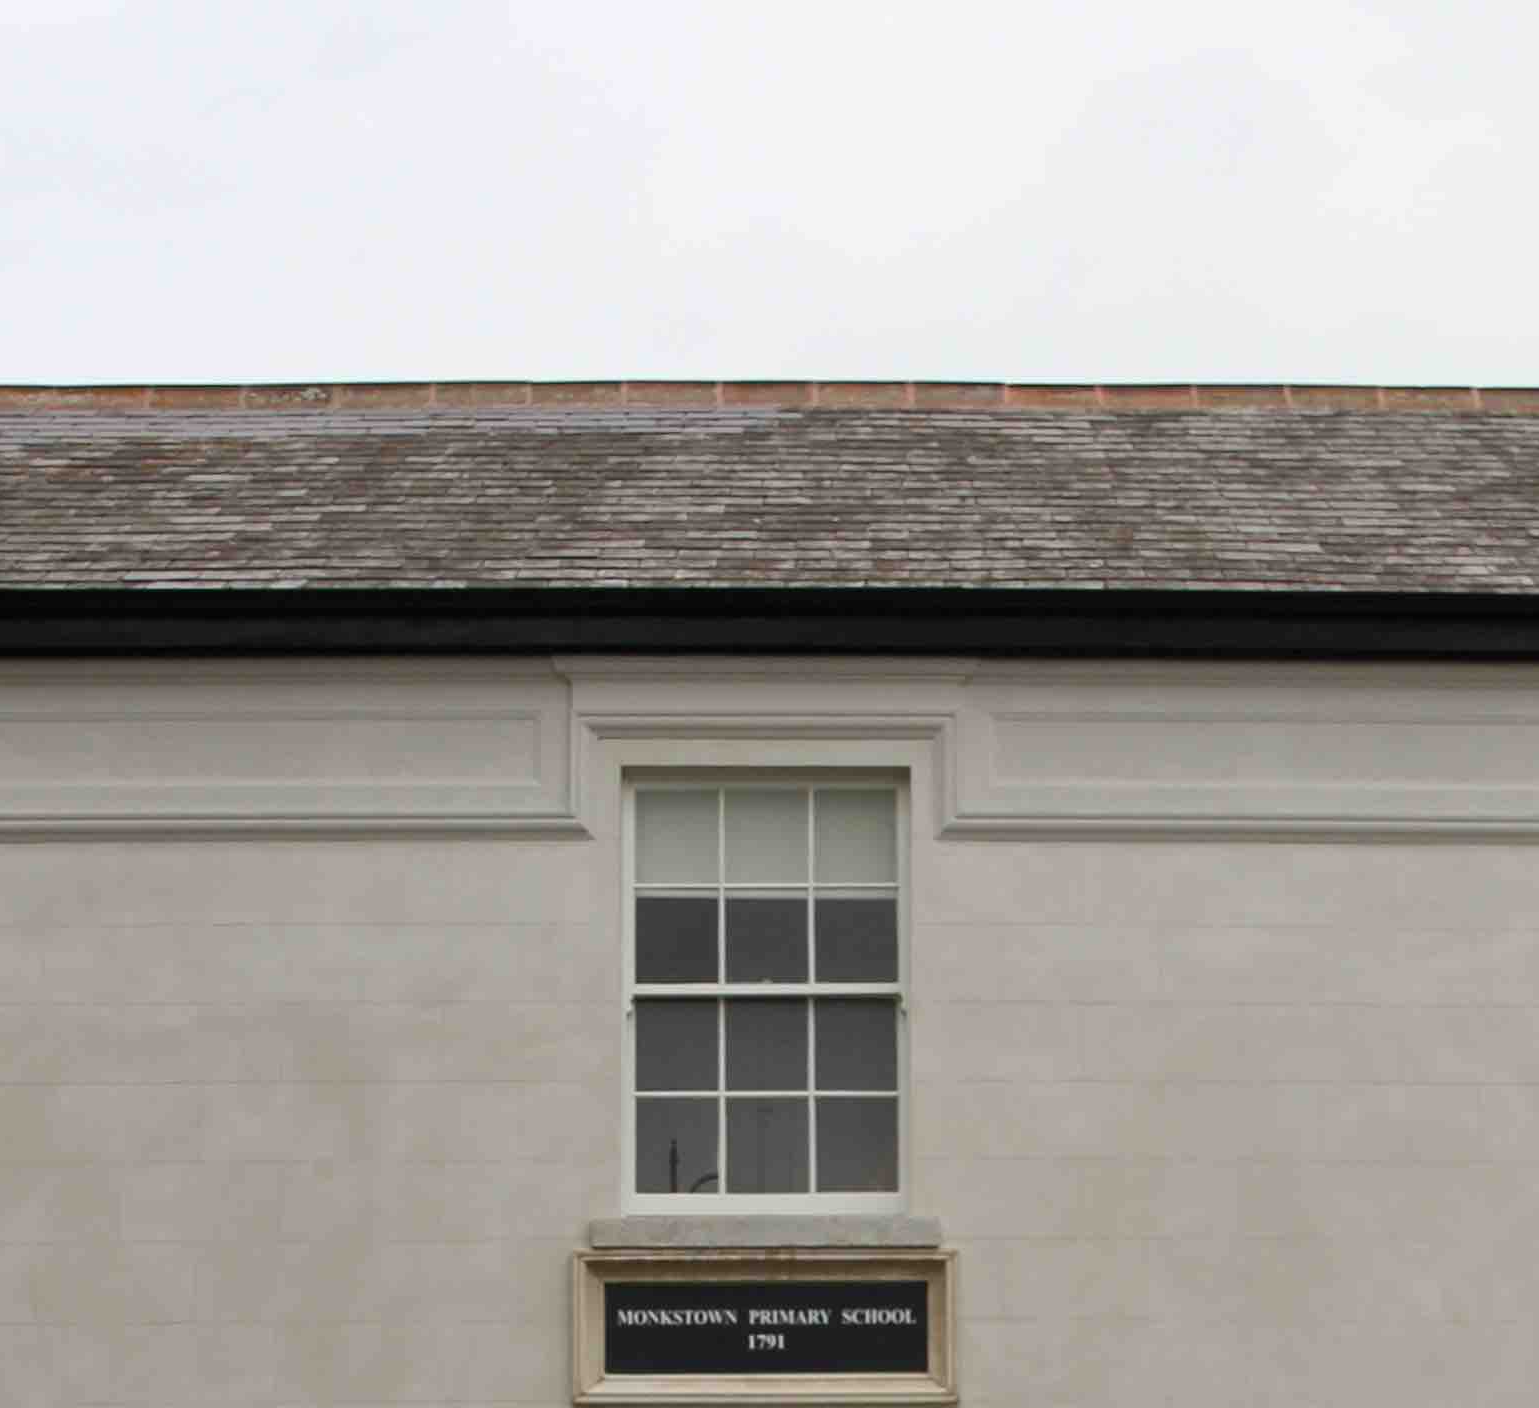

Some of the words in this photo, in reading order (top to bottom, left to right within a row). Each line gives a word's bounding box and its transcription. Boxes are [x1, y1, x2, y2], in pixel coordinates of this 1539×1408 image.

[617, 1309, 738, 1326] MONKSTOWN
[748, 1308, 832, 1326] PRIMARY
[841, 1308, 918, 1326] SCHOOL
[748, 1333, 786, 1350] 1791
